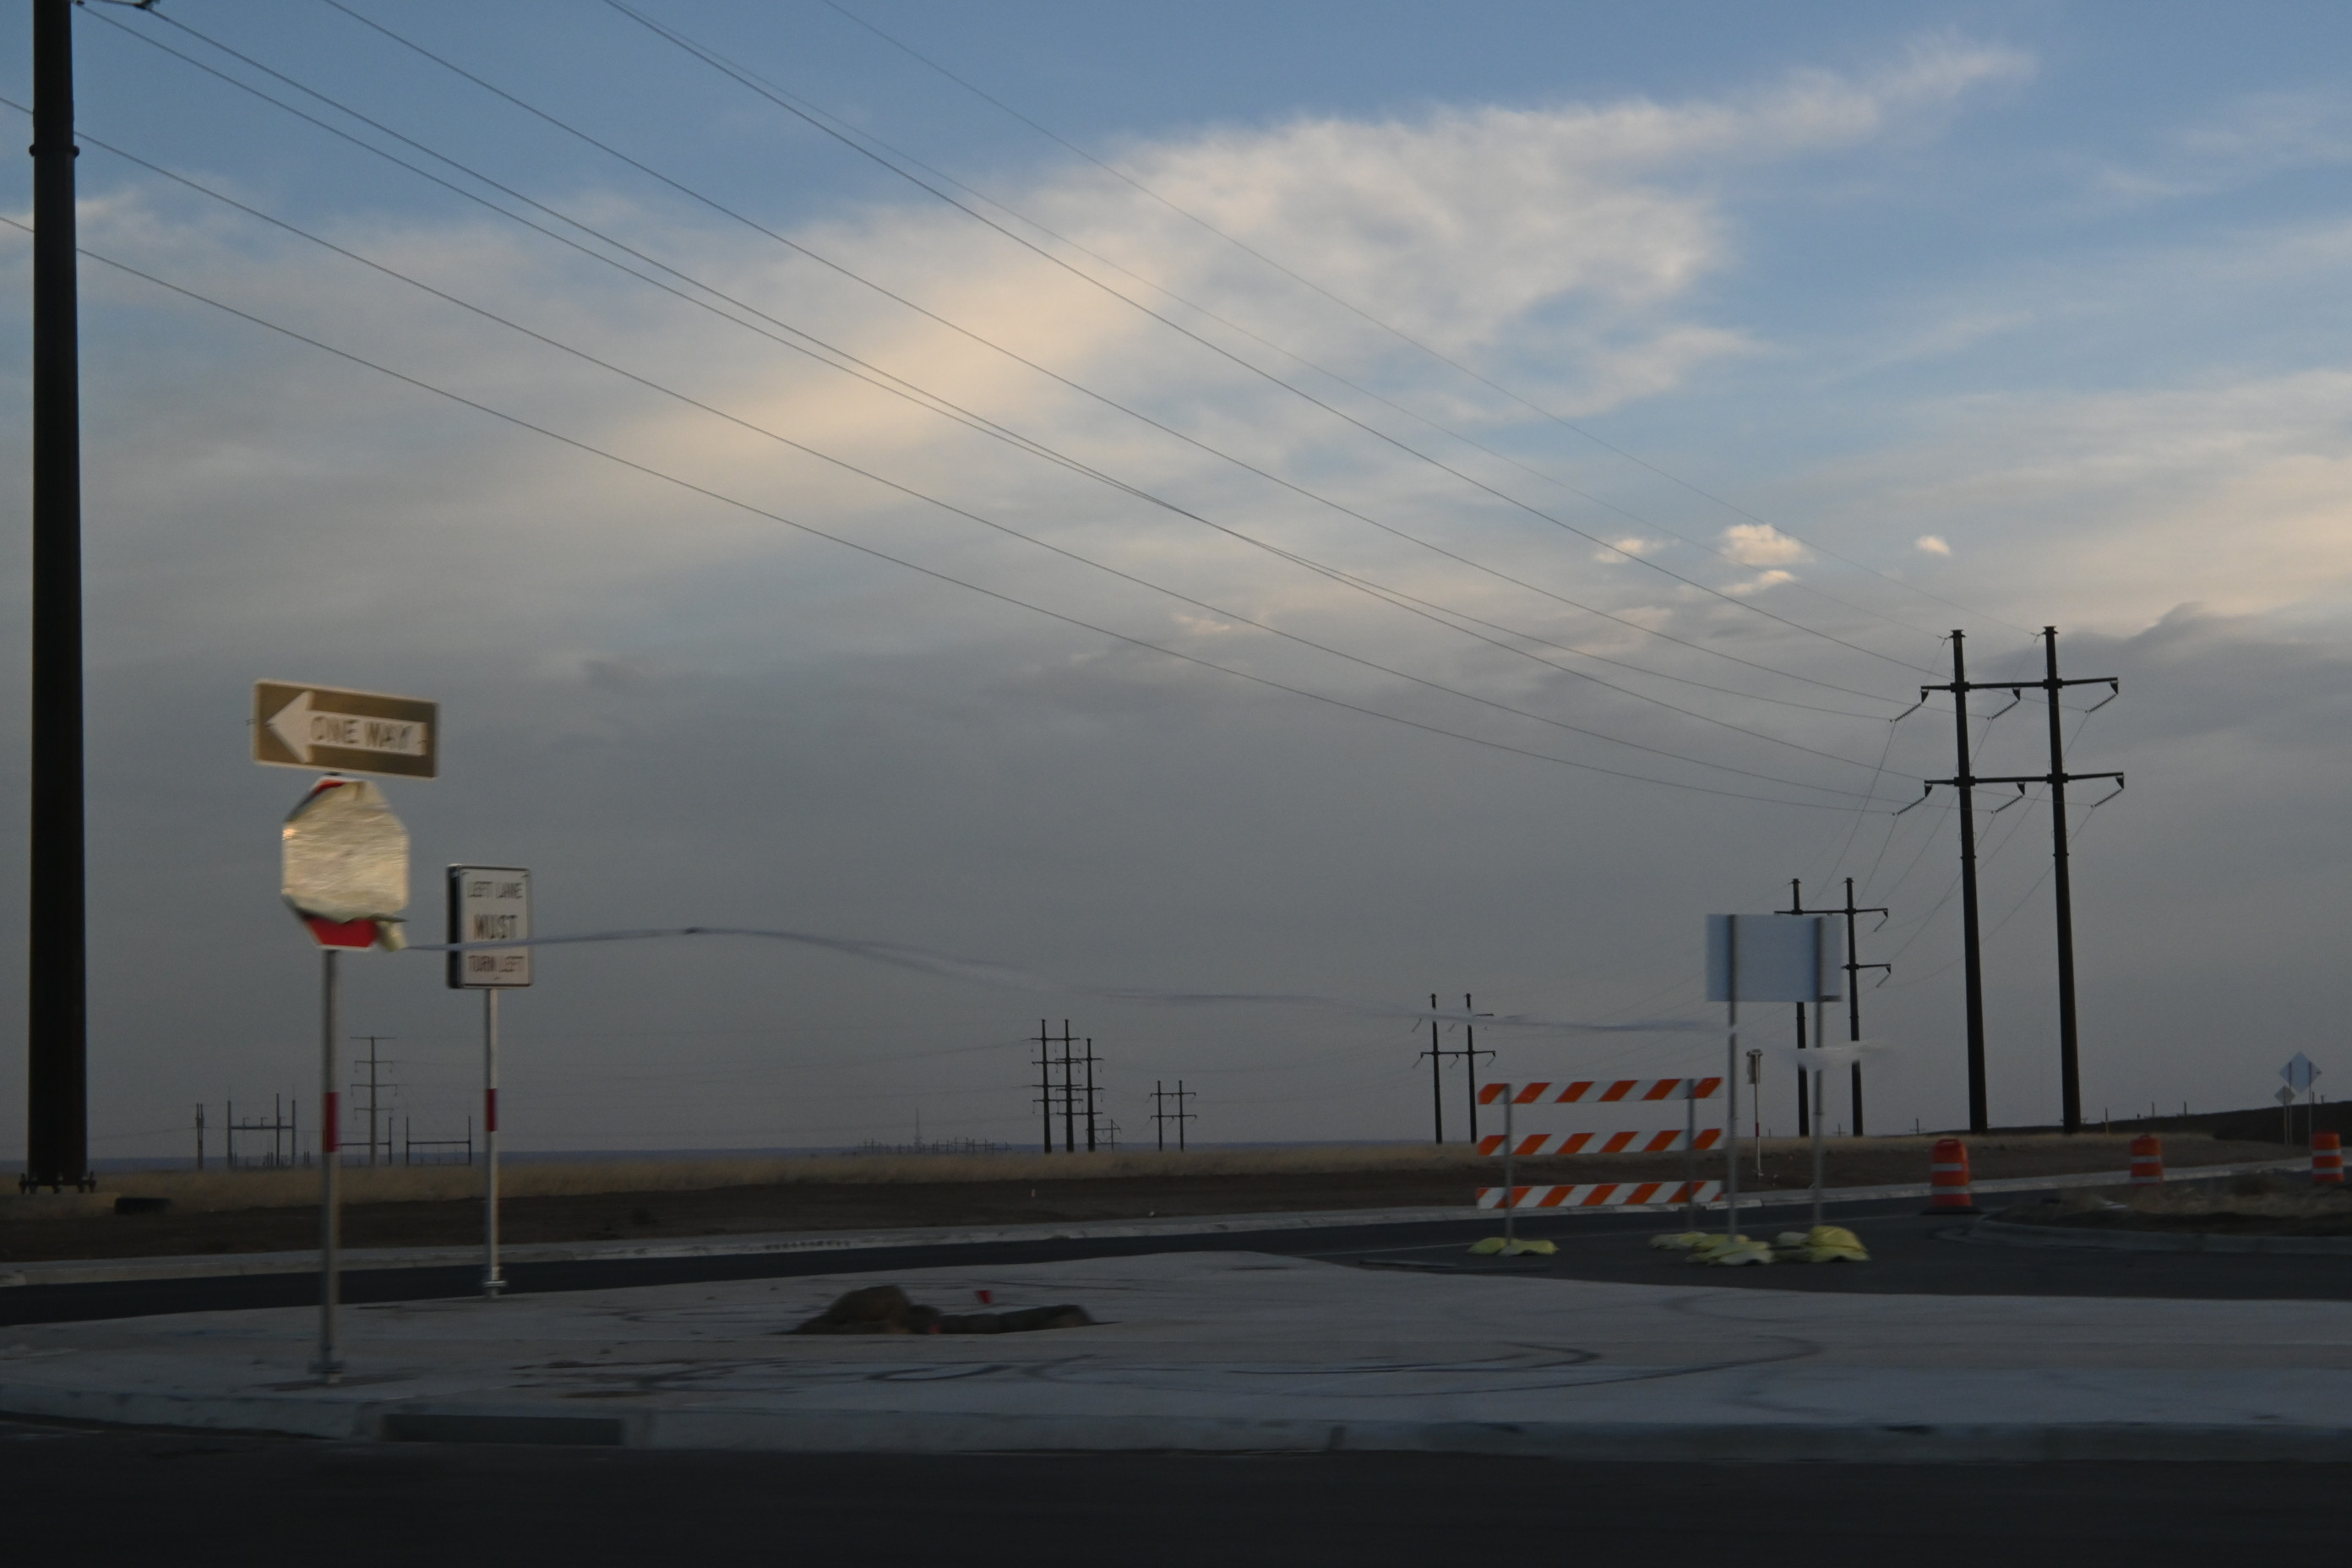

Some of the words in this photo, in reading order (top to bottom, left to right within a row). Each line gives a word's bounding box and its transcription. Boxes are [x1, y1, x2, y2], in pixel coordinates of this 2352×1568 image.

[311, 716, 358, 743] ONE
[364, 721, 413, 749] WAY
[466, 881, 493, 898] LEFT
[495, 882, 523, 899] LANE
[474, 914, 517, 940] MUST
[468, 956, 495, 972] TURN
[498, 956, 525, 972] LEFT
